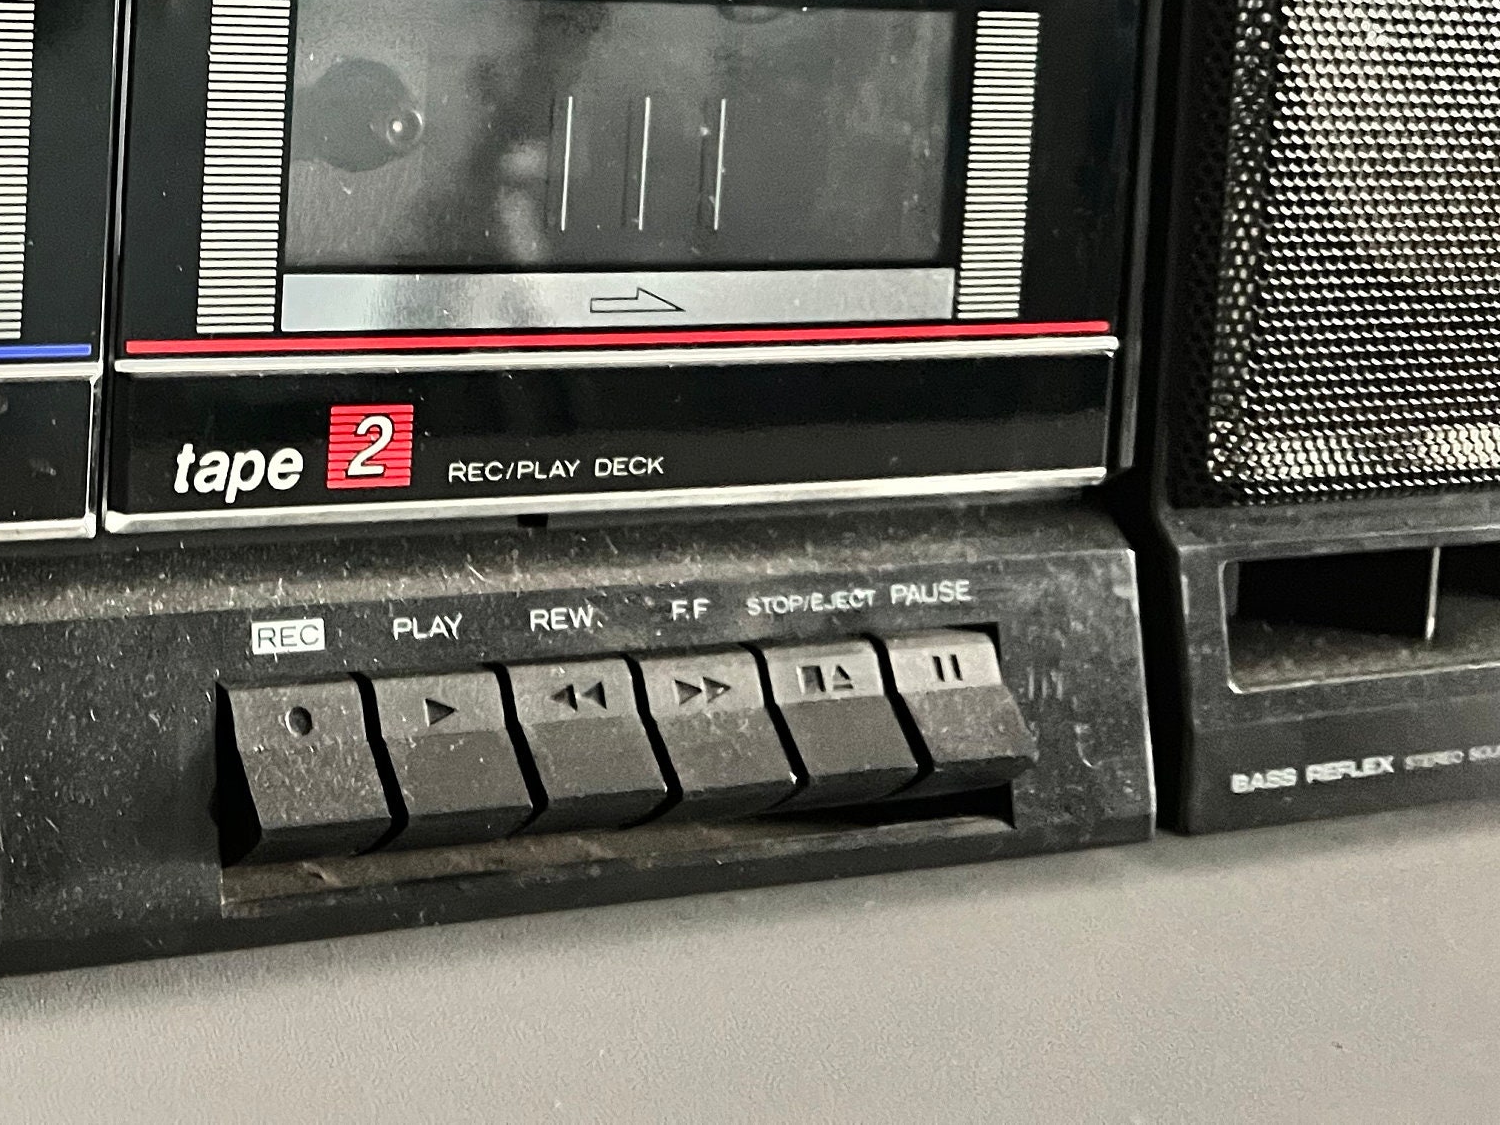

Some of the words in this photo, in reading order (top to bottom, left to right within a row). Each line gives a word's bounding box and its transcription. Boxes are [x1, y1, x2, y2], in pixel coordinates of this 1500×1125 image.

[174, 442, 304, 503] tape
[347, 414, 394, 476] 2
[448, 458, 581, 483] REC/PLAY
[594, 456, 664, 477] DECK
[746, 588, 875, 618] STOP/EJECT
[890, 579, 971, 605] PAUSE
[258, 623, 320, 650] REC
[393, 613, 463, 641] PLAY
[1231, 767, 1297, 794] BASS
[1305, 755, 1394, 784] REFLEX
